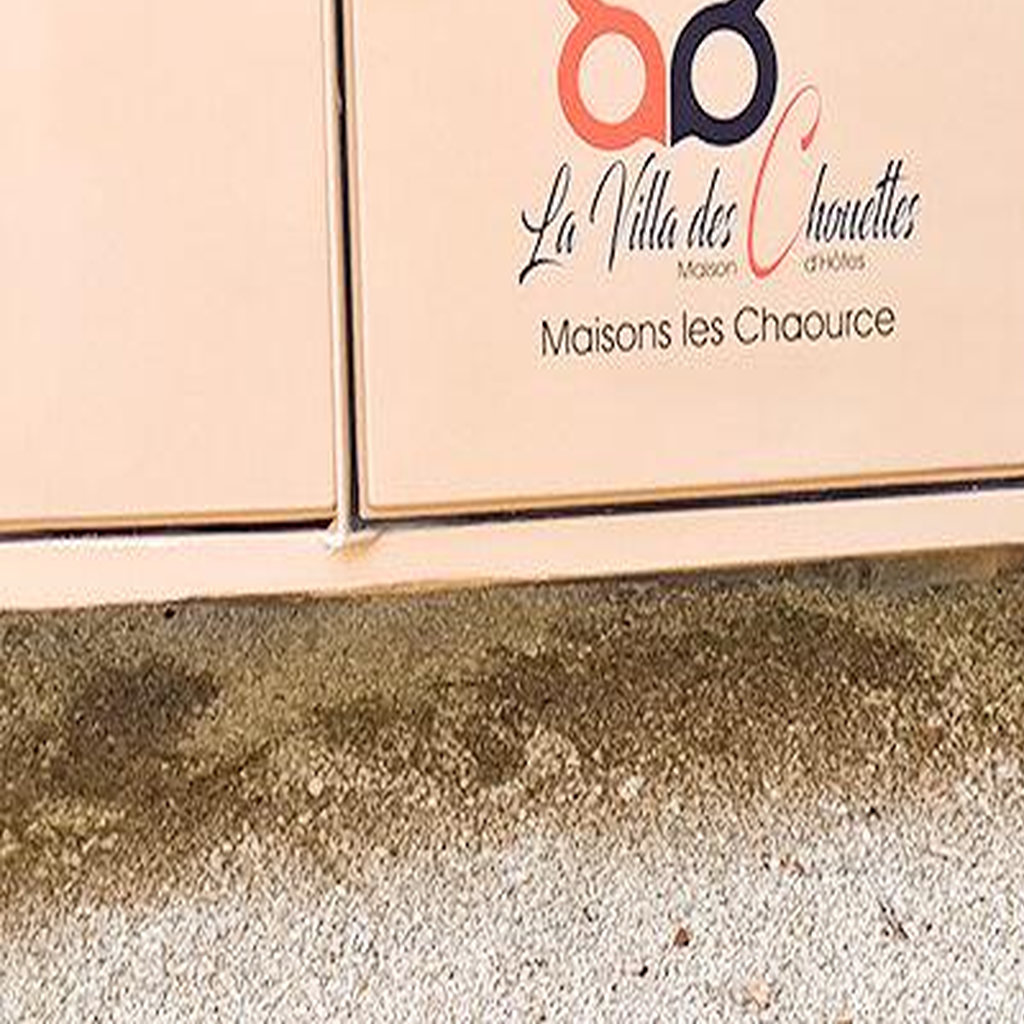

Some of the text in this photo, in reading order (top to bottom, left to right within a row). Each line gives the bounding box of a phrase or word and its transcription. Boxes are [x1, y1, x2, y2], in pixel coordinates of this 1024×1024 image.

[519, 85, 920, 284] La Villa des Chouettes
[678, 259, 738, 279] Maison
[541, 305, 897, 356] Maisons les Chaource
